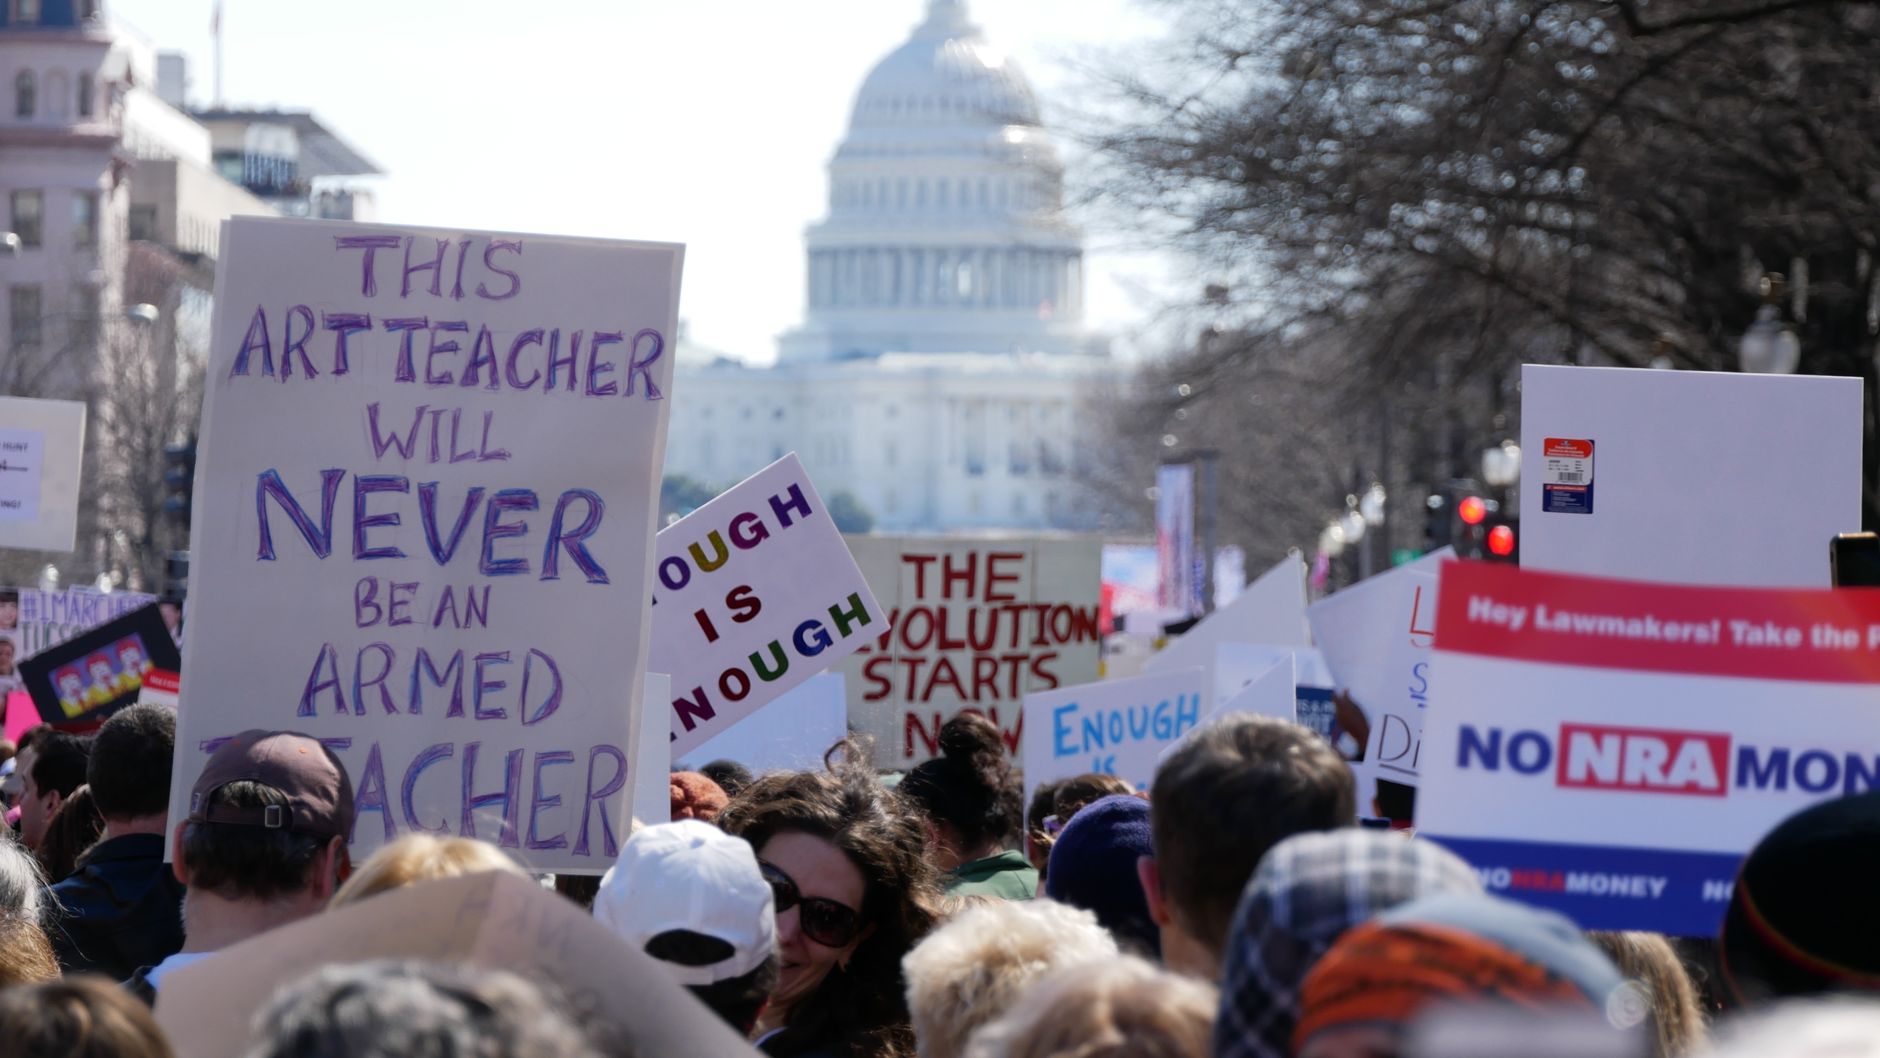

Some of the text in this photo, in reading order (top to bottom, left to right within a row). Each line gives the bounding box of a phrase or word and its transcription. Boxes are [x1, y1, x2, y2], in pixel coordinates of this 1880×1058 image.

[334, 234, 522, 300] THIS
[230, 304, 663, 400] ART TEACHER
[366, 403, 511, 463] WILL
[257, 468, 609, 584] NEVER
[652, 483, 812, 606] OUGH
[354, 576, 492, 629] BE AN
[903, 553, 1023, 602] THE
[694, 585, 761, 643] IS
[1467, 594, 1527, 632] Hey
[1534, 604, 1720, 645] Lawmakers!
[1729, 619, 1802, 647] Take
[1811, 623, 1860, 649] the
[297, 643, 563, 726] ARMED
[670, 592, 871, 742] NOUGH
[863, 652, 1060, 703] STARTS
[905, 706, 1023, 759] NW
[1054, 693, 1199, 757] ENOUGH
[1456, 724, 1552, 775] NO
[1564, 731, 1721, 789] NRA
[200, 736, 628, 857] ACHER
